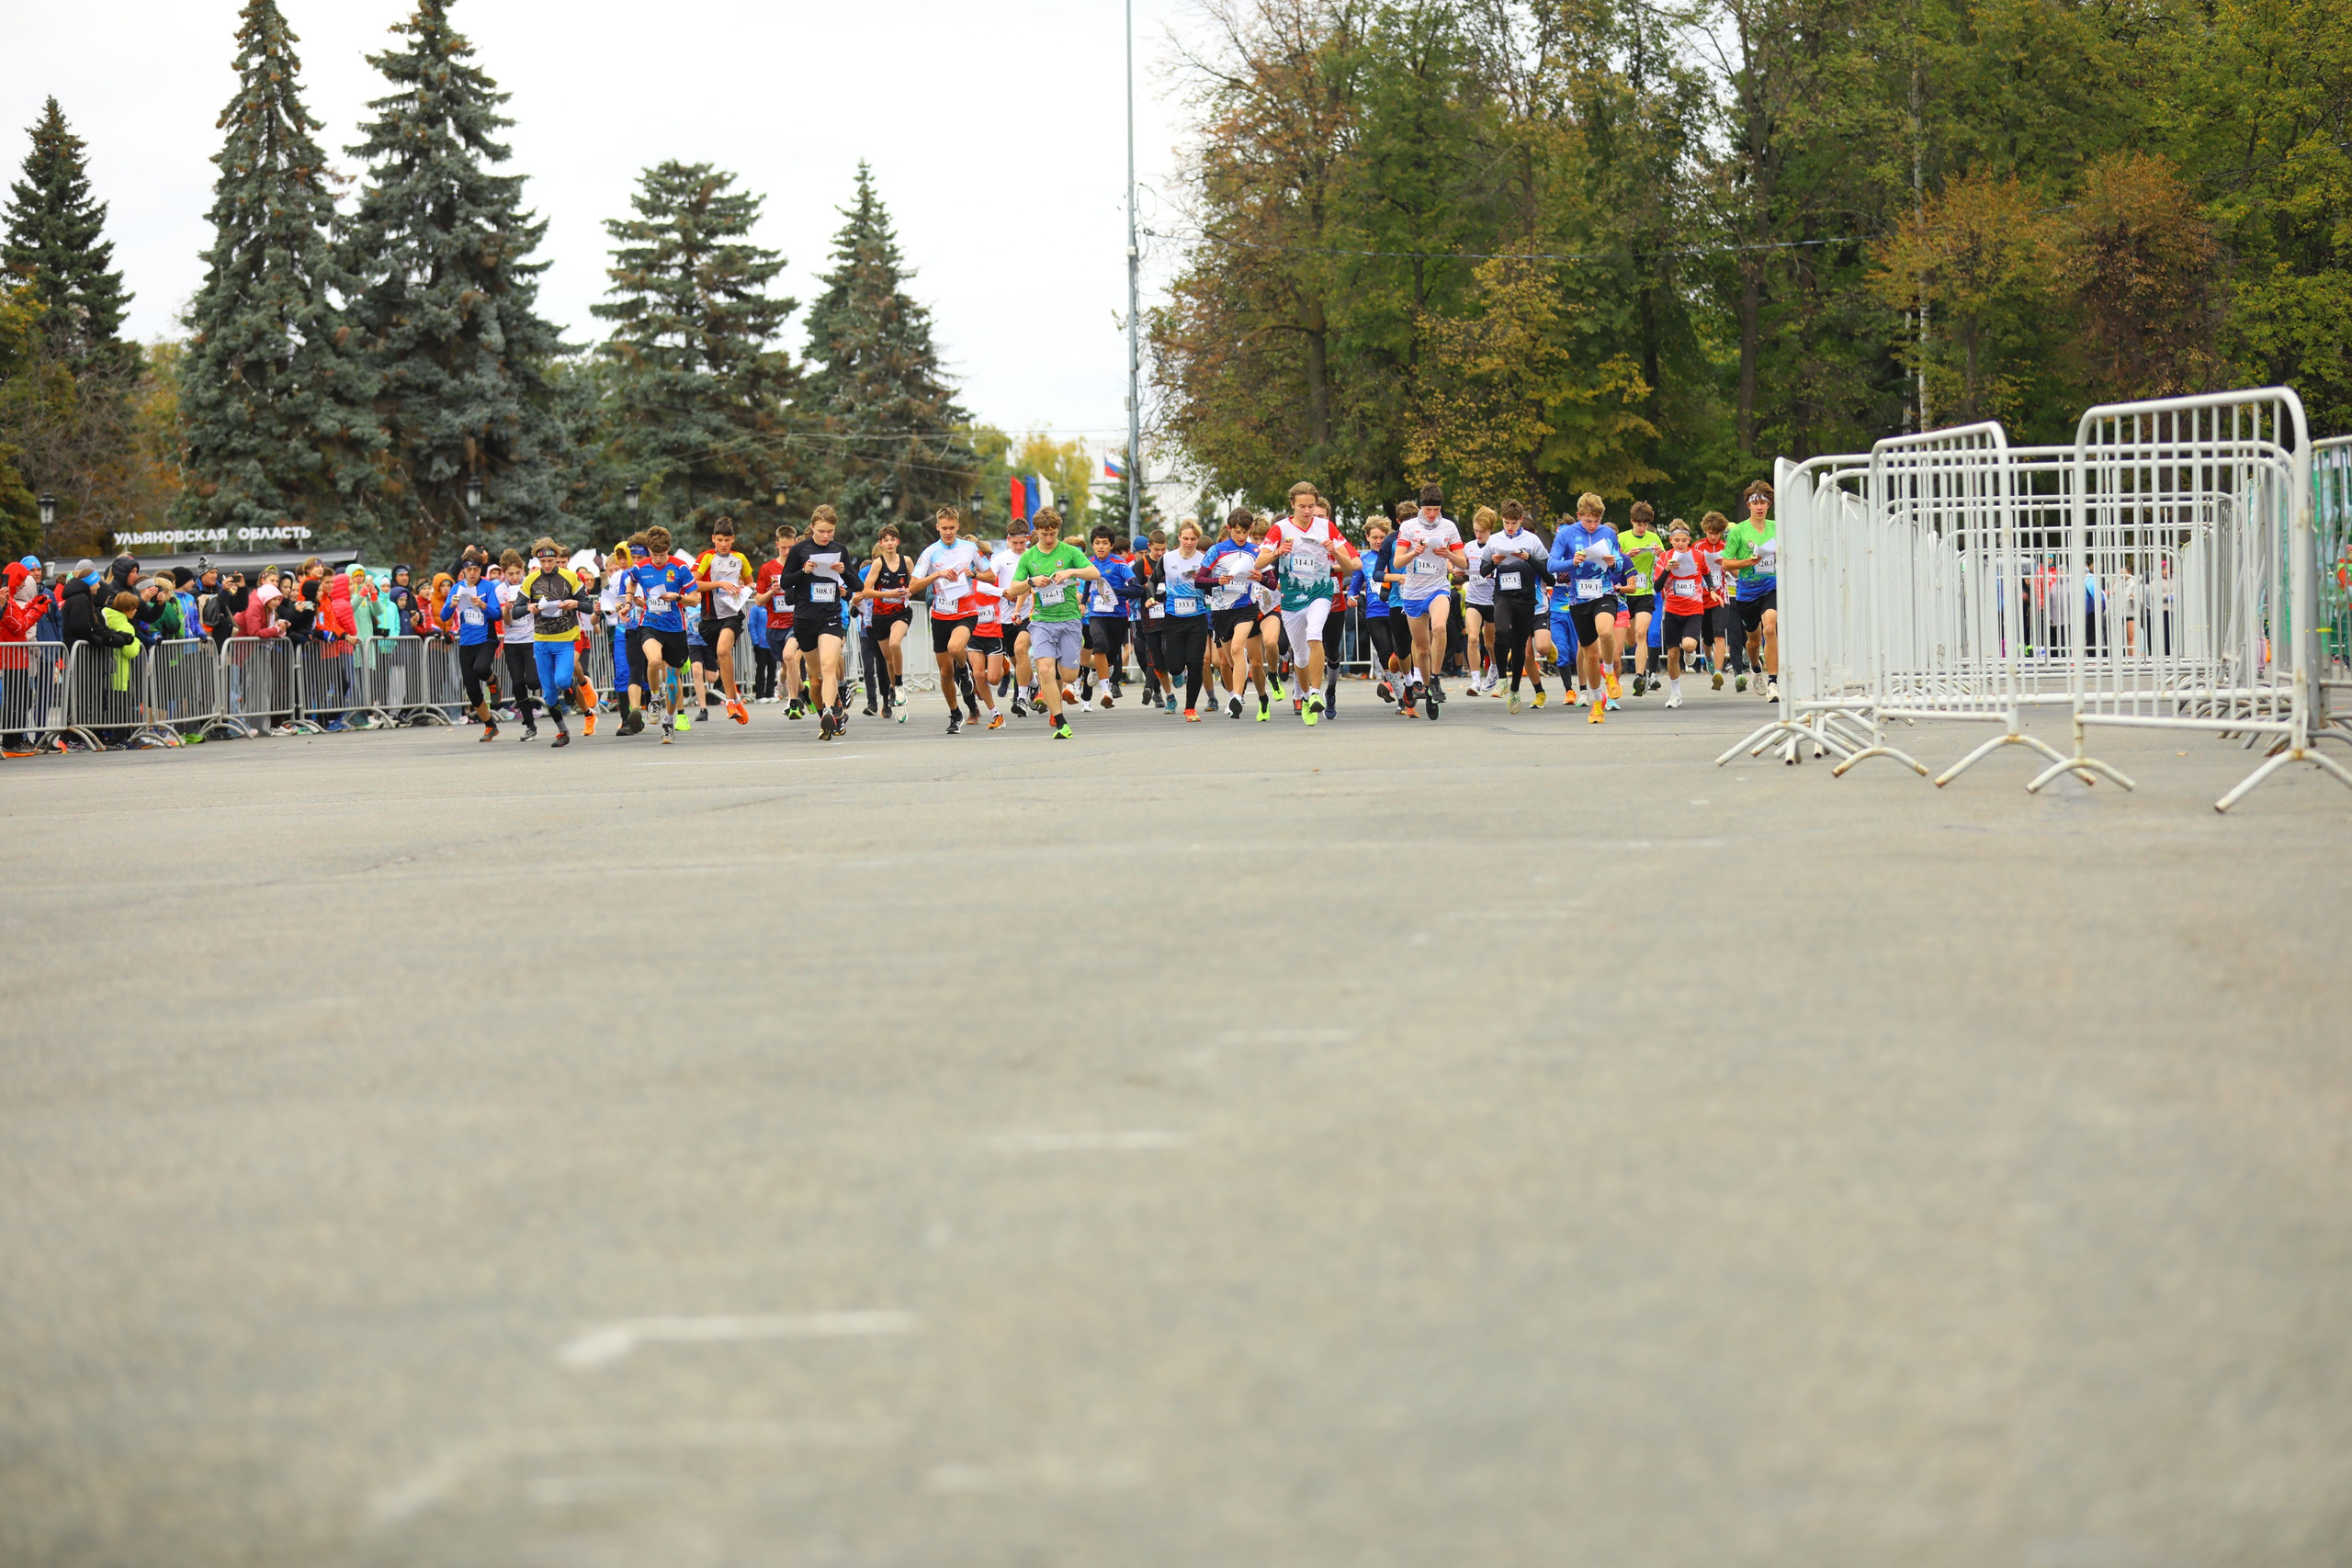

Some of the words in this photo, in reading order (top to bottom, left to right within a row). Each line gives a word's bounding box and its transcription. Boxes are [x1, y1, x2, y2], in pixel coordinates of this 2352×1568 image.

[114, 528, 228, 545] УЛЬЯНОВСКАЯ
[238, 526, 311, 540] ОБЛАСТЬ
[938, 597, 955, 605] 32.1
